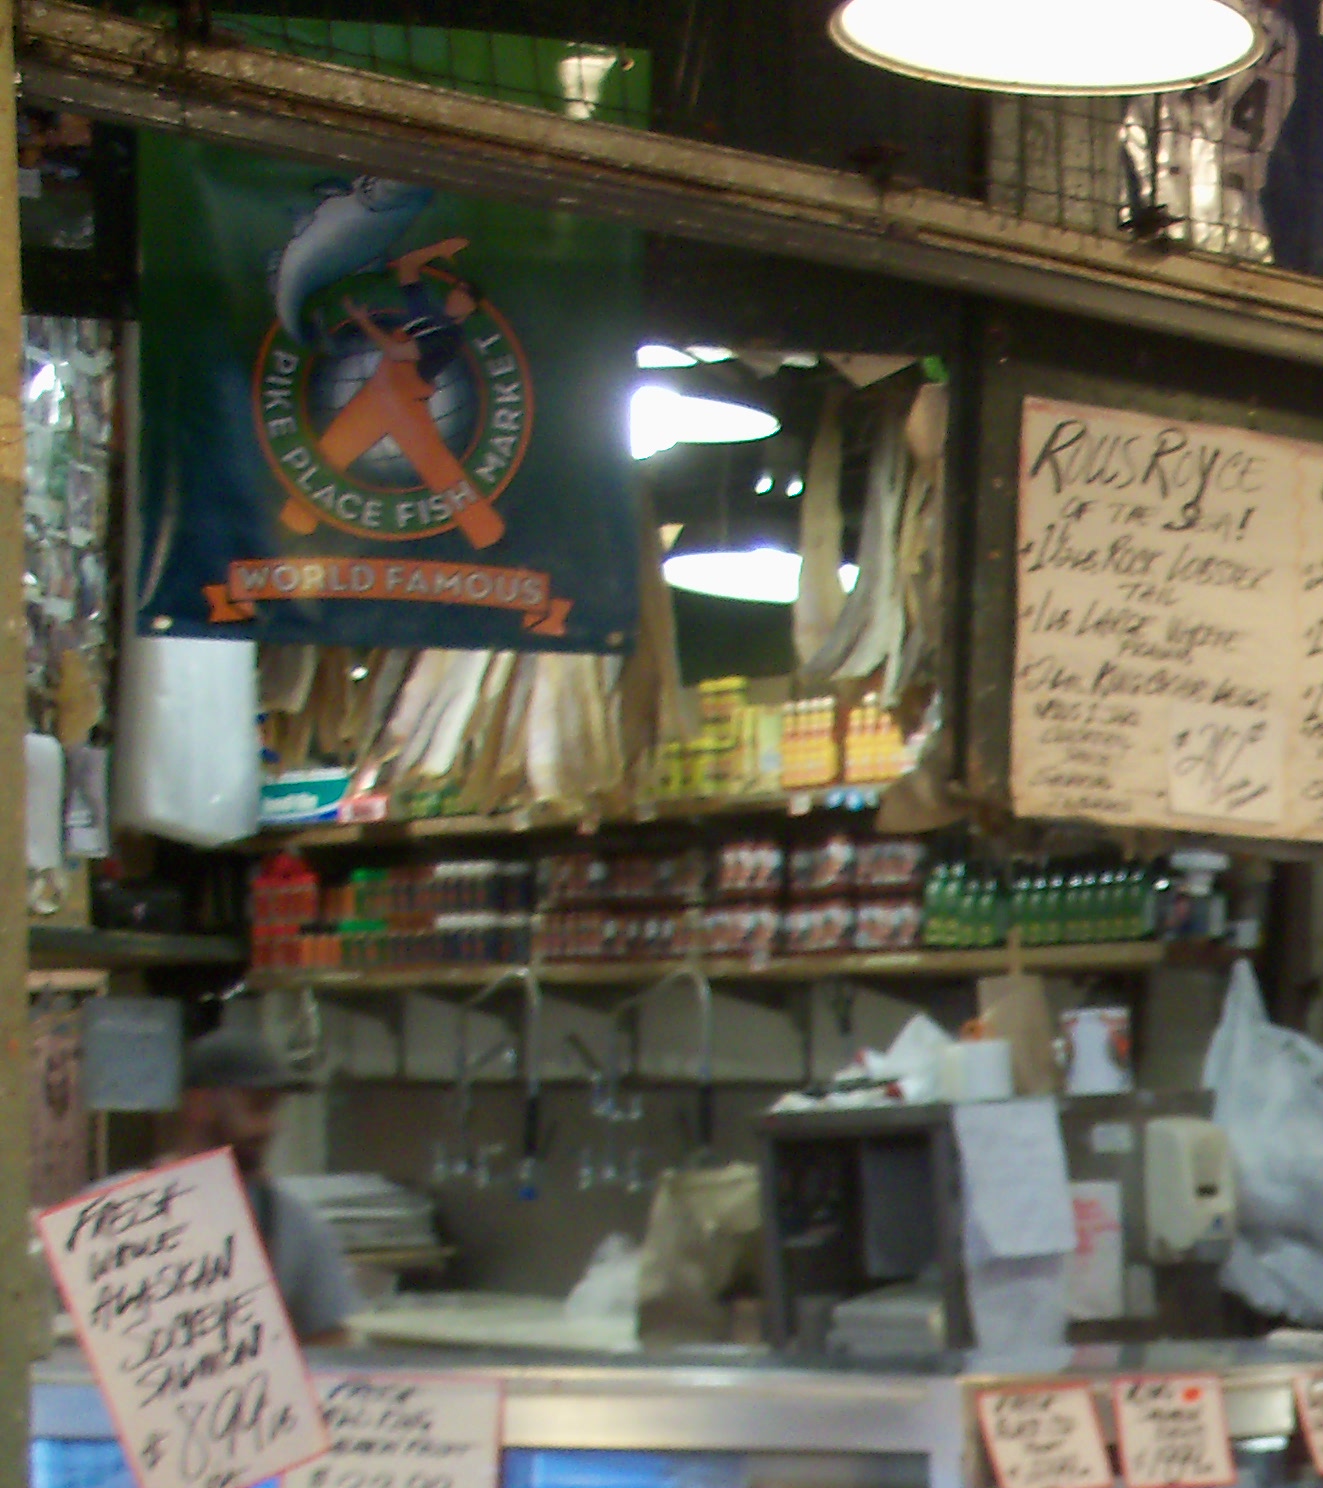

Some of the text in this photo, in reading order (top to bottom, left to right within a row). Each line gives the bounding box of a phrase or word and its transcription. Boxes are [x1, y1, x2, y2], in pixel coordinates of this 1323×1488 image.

[264, 333, 521, 528] PIKE PLACE FISH MARKET
[1030, 418, 1268, 503] ROLLS ROYCE
[236, 565, 544, 604] WORLD FAMOUS
[65, 1182, 197, 1251] FRESH
[89, 1222, 191, 1281] WHOLE
